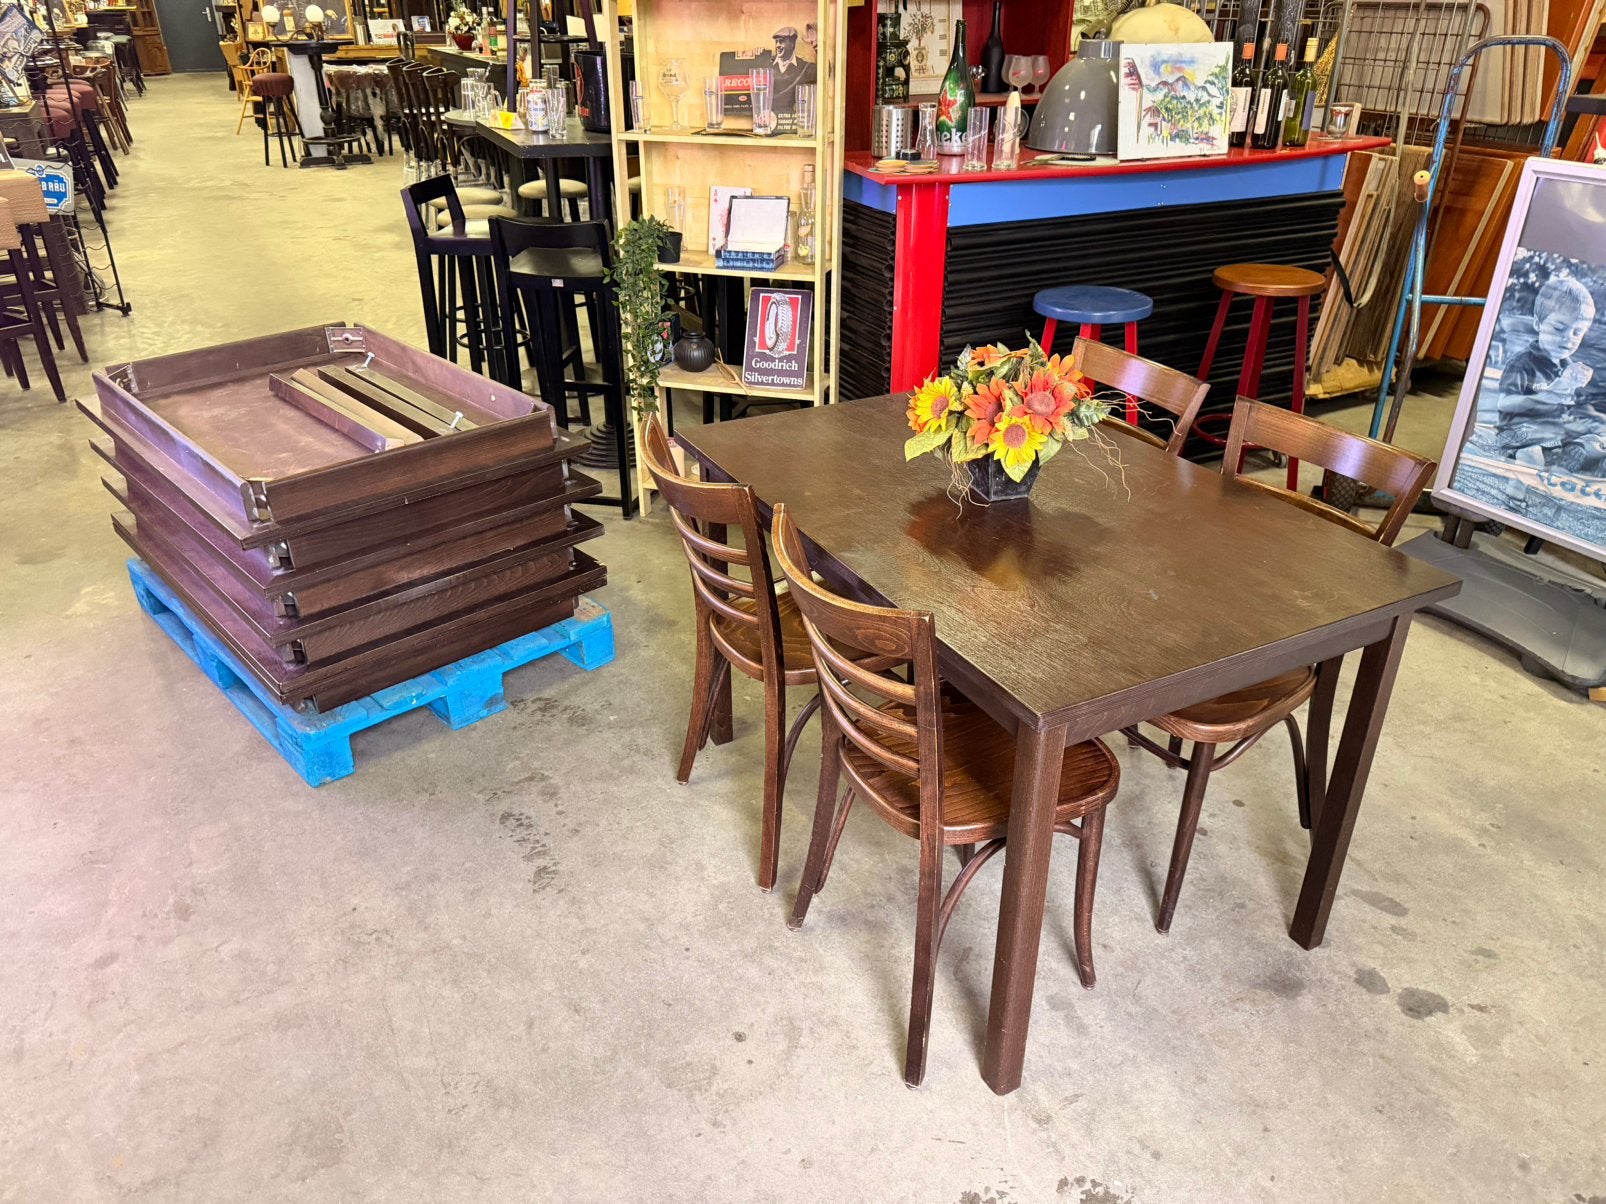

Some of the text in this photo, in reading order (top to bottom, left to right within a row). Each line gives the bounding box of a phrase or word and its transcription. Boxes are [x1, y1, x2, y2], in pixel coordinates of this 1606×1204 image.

[724, 78, 764, 88] RECO
[41, 180, 66, 192] BRÄU
[752, 357, 798, 370] Goodrich
[745, 371, 803, 385] Silvertowns
